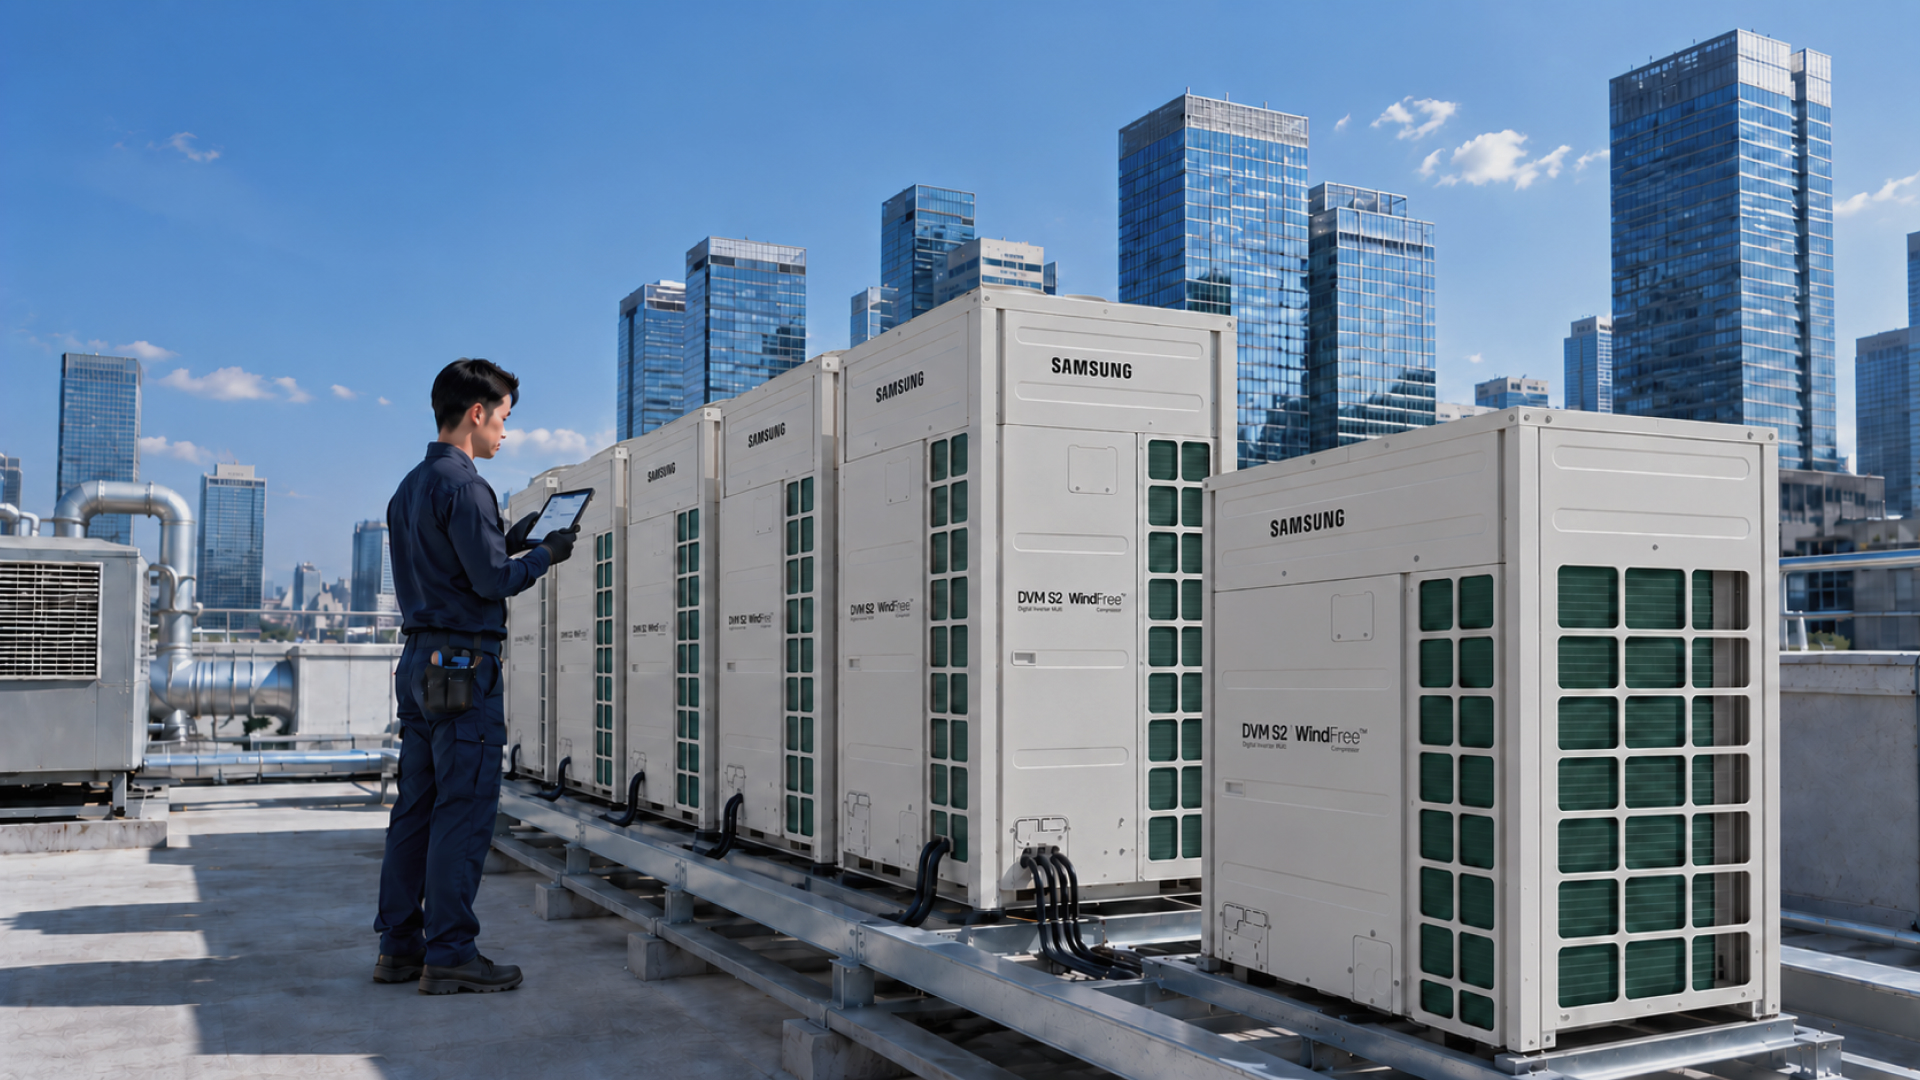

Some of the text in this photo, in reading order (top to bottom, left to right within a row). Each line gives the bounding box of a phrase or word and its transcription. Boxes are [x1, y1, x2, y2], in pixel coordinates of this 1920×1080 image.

[1051, 356, 1132, 379] SAMSUNG
[875, 371, 924, 403] SAMSUNG
[748, 422, 785, 449] SAMSUNG
[1270, 509, 1345, 538] SAMSUNG
[1018, 591, 1045, 604] DVM
[1048, 592, 1062, 604] S2
[1242, 723, 1269, 740] DVM
[1272, 724, 1287, 741] S2
